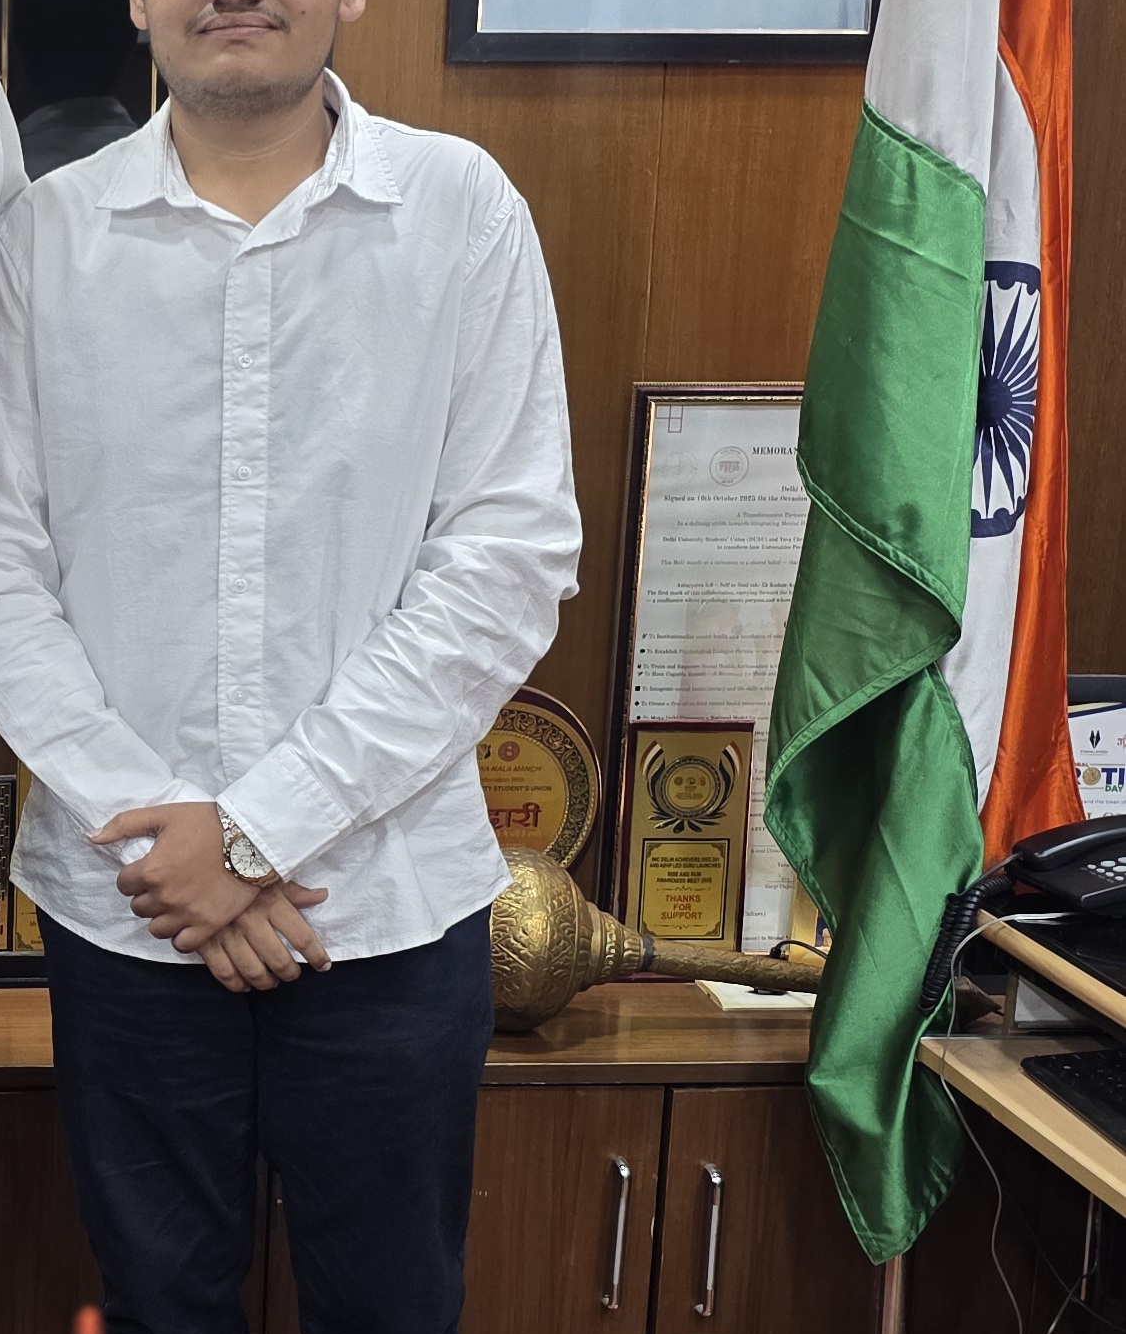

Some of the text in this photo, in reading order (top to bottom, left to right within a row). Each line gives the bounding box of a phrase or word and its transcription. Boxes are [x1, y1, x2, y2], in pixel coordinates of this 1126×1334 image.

[665, 894, 701, 902] THANKS
[673, 903, 691, 911] FOR
[661, 911, 703, 920] SUPPORT
